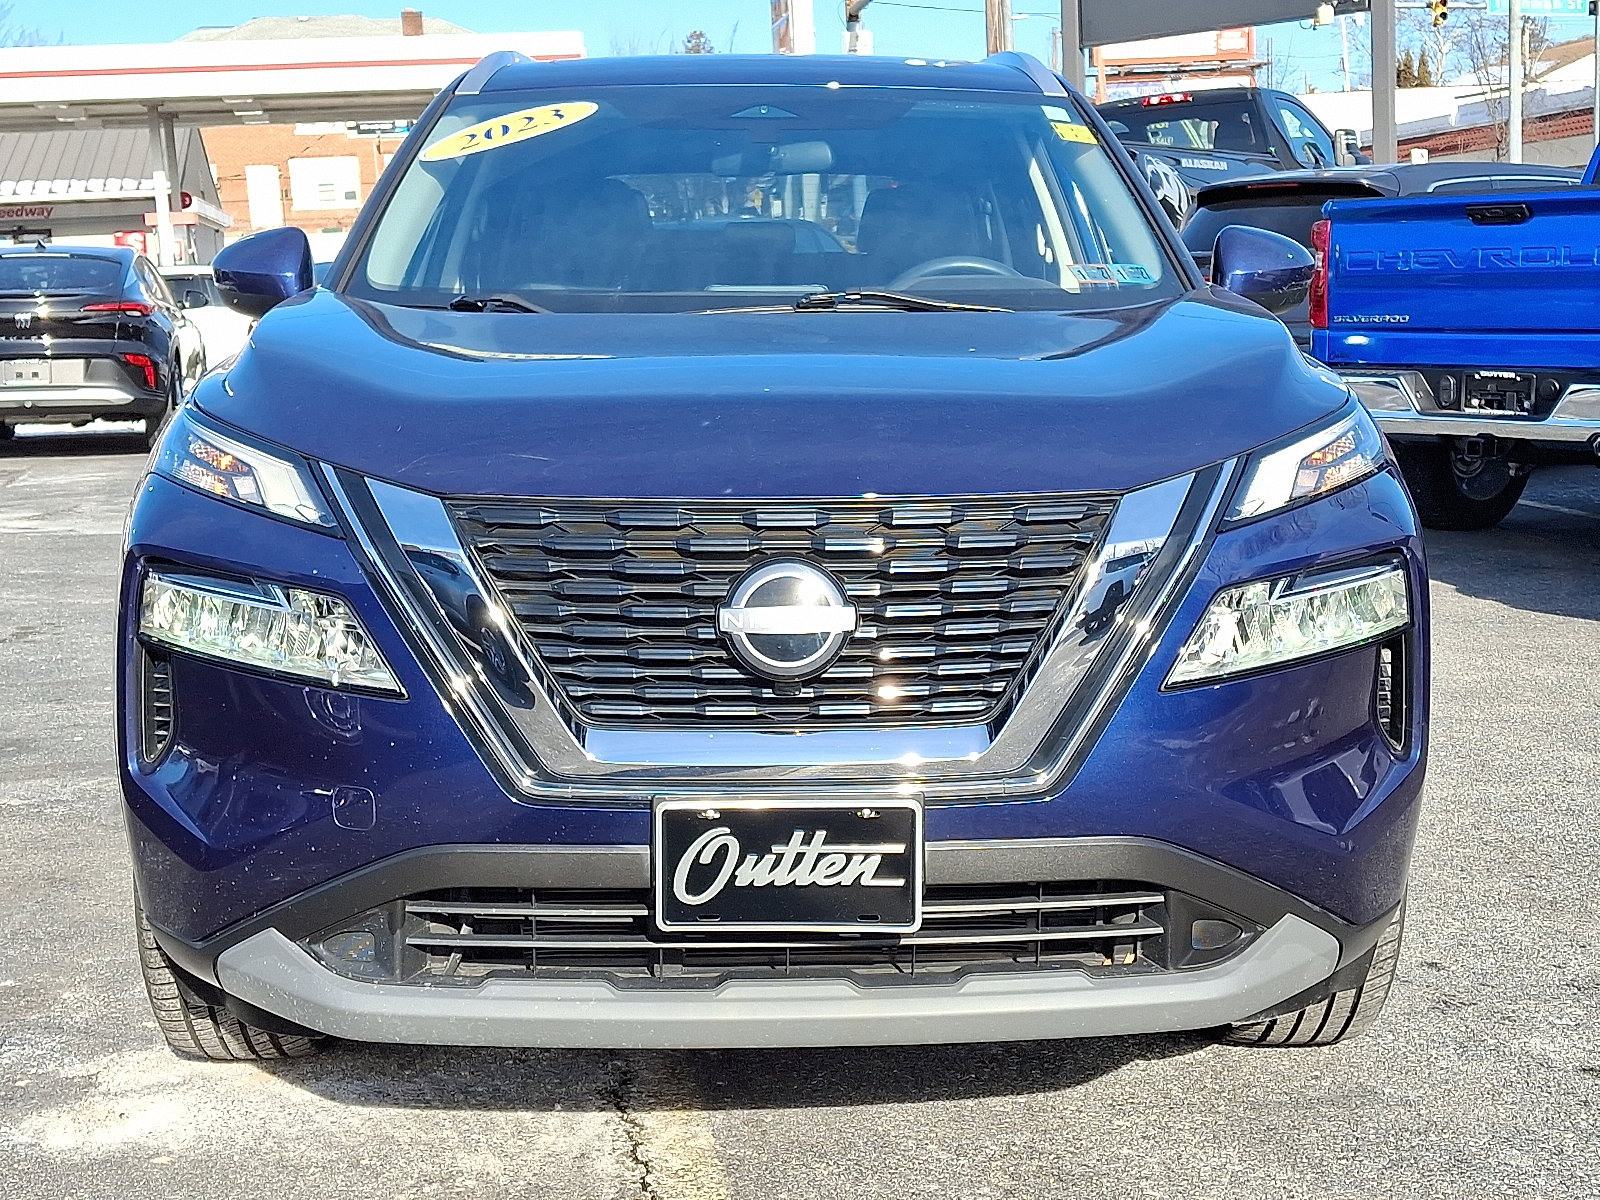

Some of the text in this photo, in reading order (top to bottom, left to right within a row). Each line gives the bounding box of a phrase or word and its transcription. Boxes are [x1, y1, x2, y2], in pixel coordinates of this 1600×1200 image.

[460, 108, 566, 151] 2023
[1181, 158, 1229, 171] ALASKAN
[1346, 246, 1600, 271] CHEVROL
[1333, 315, 1410, 323] SILVERADO
[673, 827, 906, 905] Outten
